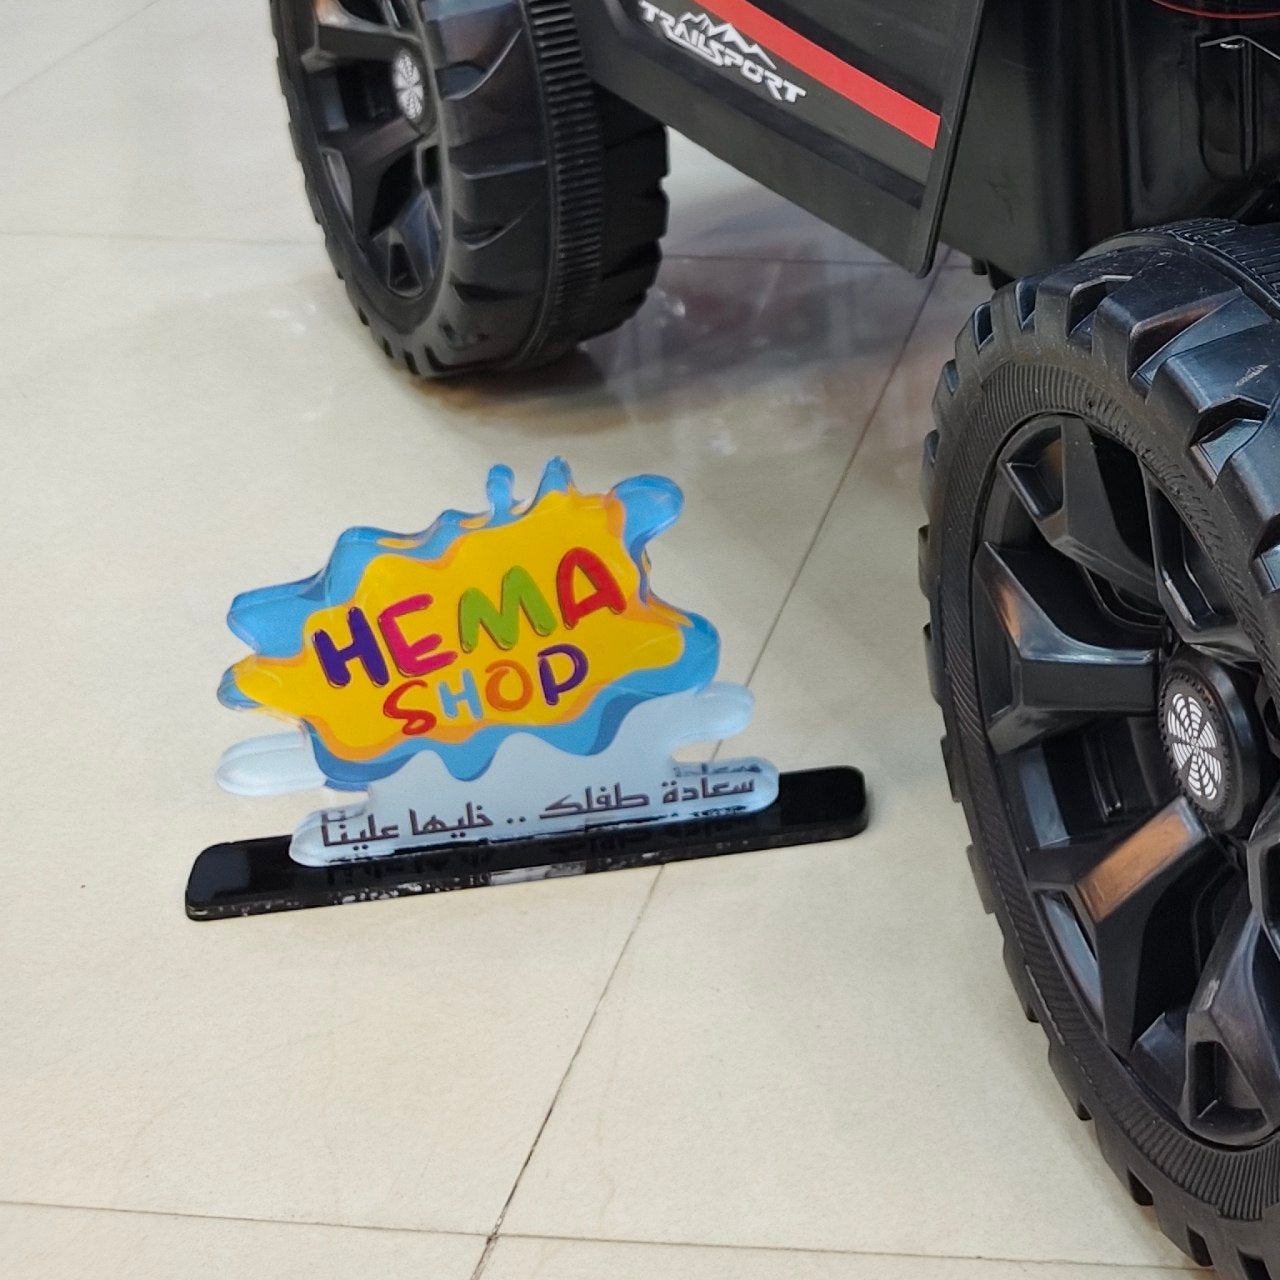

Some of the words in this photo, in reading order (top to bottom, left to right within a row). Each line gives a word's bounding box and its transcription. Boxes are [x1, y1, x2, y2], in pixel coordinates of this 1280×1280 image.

[312, 546, 628, 688] HEMA
[383, 643, 589, 736] SHOP
[539, 781, 650, 819] طفلك
[662, 776, 756, 804] سعادة
[320, 813, 399, 851] علينا
[408, 801, 495, 838] خليها
